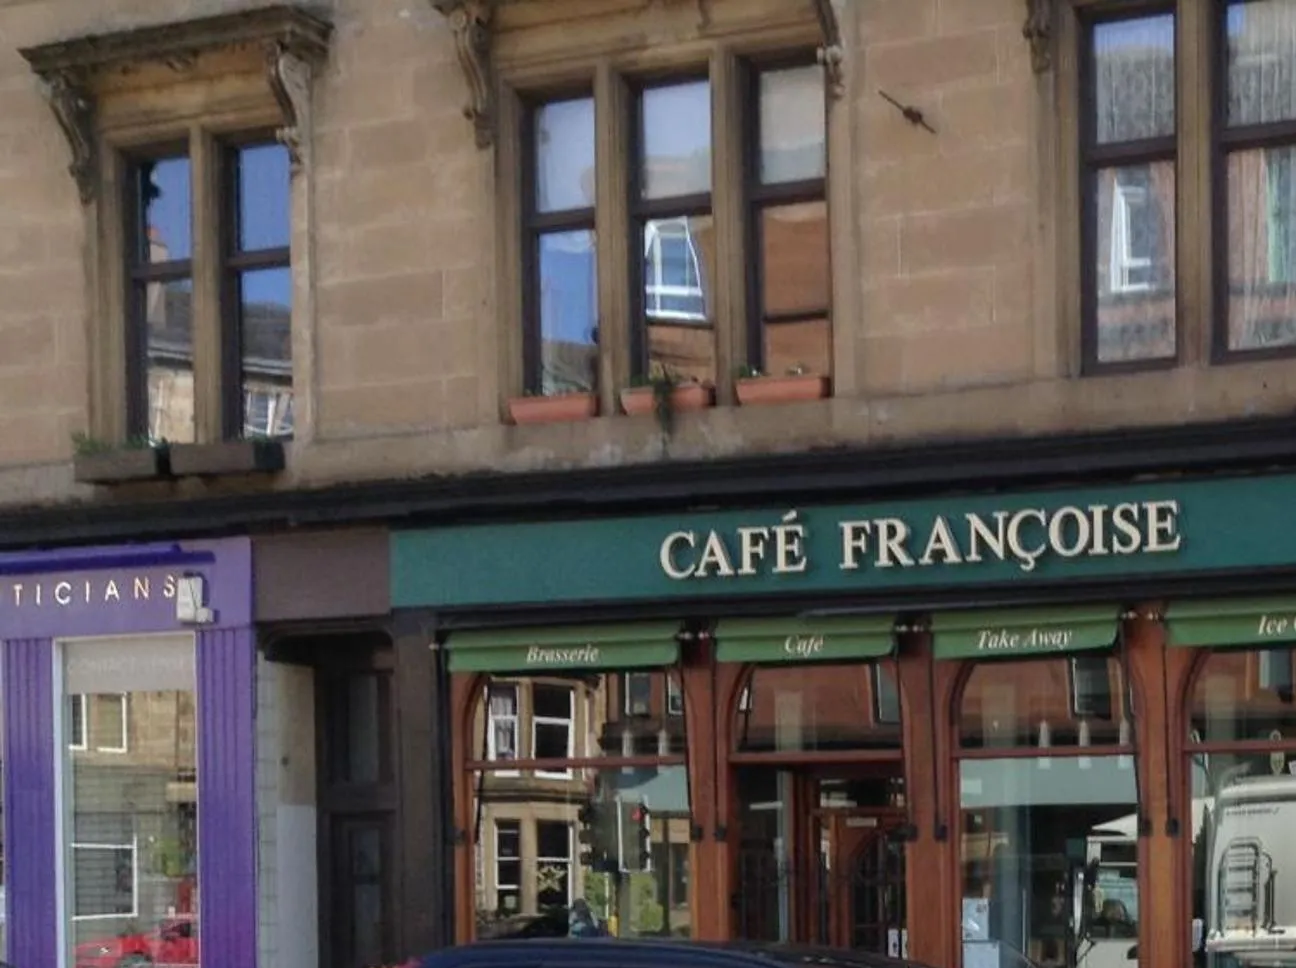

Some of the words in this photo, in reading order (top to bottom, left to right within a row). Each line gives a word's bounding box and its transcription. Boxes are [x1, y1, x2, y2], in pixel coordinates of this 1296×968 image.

[660, 511, 808, 580] CAFÉ
[838, 500, 1183, 571] FRANÇOISE
[13, 575, 177, 607] TICIANS
[1258, 614, 1288, 636] Ice
[784, 634, 825, 658] Café
[977, 629, 1020, 650] Take
[1021, 627, 1073, 649] Away
[526, 643, 600, 664] Brasserie
